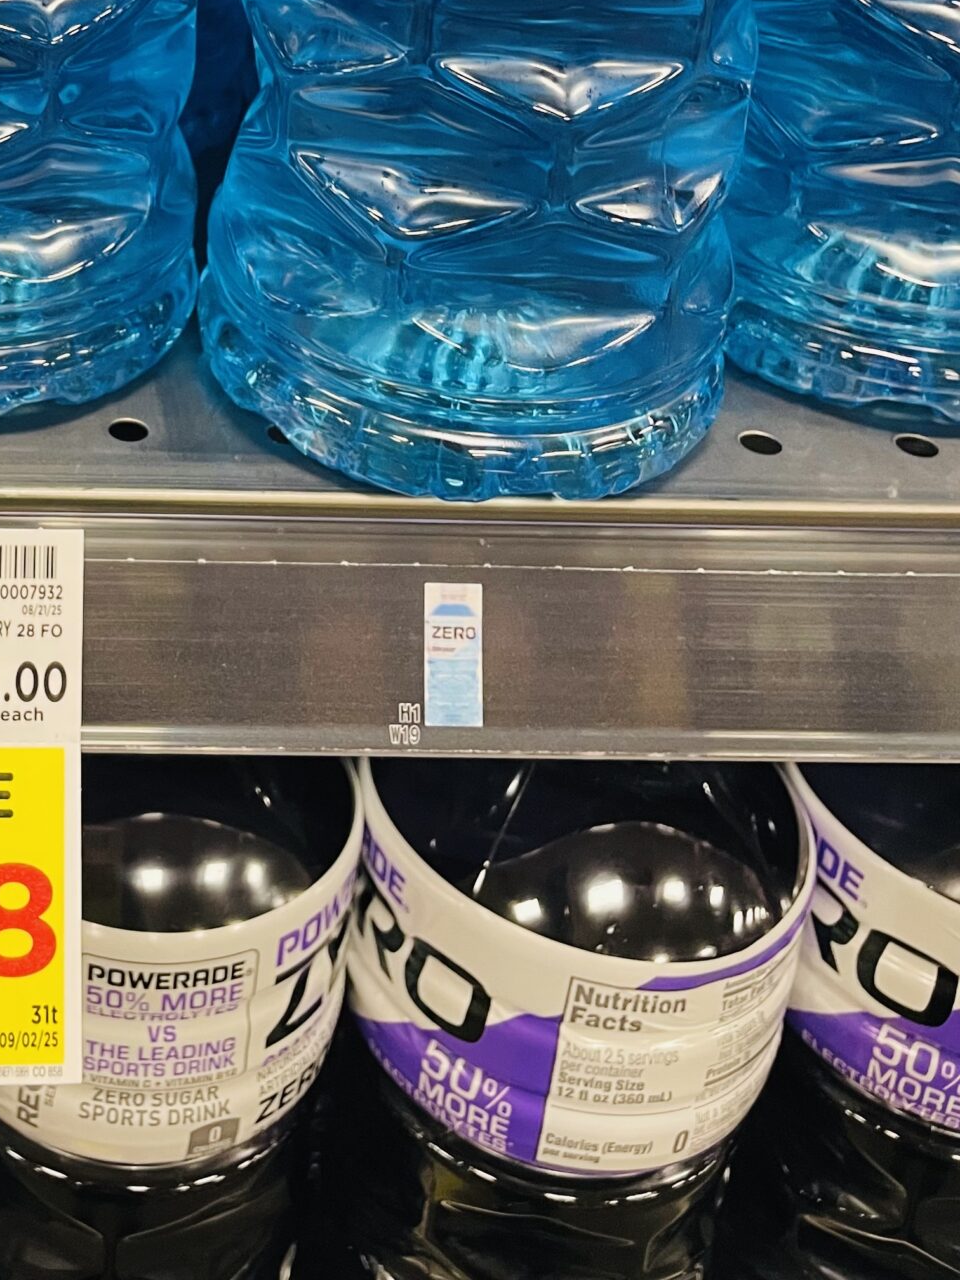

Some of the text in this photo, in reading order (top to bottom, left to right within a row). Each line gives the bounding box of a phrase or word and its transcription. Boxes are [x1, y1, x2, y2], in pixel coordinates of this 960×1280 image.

[16, 624, 35, 638] 28
[41, 624, 63, 638] FO
[432, 626, 476, 640] ZERO
[0, 708, 44, 721] each
[88, 961, 246, 990] POWERADE
[86, 982, 243, 1012] 50% MORE
[574, 984, 688, 1014] Nutrition
[570, 1006, 642, 1032] Facts
[0, 1032, 58, 1050] 09/02/25
[147, 1025, 177, 1042] VS
[86, 1037, 236, 1061] THE LEADING
[83, 1052, 235, 1077] SPORTS DRINK
[557, 1087, 576, 1099] 12
[558, 1072, 645, 1092] Serving Size
[93, 1085, 218, 1106] ZERO SUGAR
[79, 1103, 160, 1126] SPORTS
[168, 1100, 230, 1125] DRINK
[546, 1132, 599, 1152] Calories
[672, 1130, 689, 1154] 0
